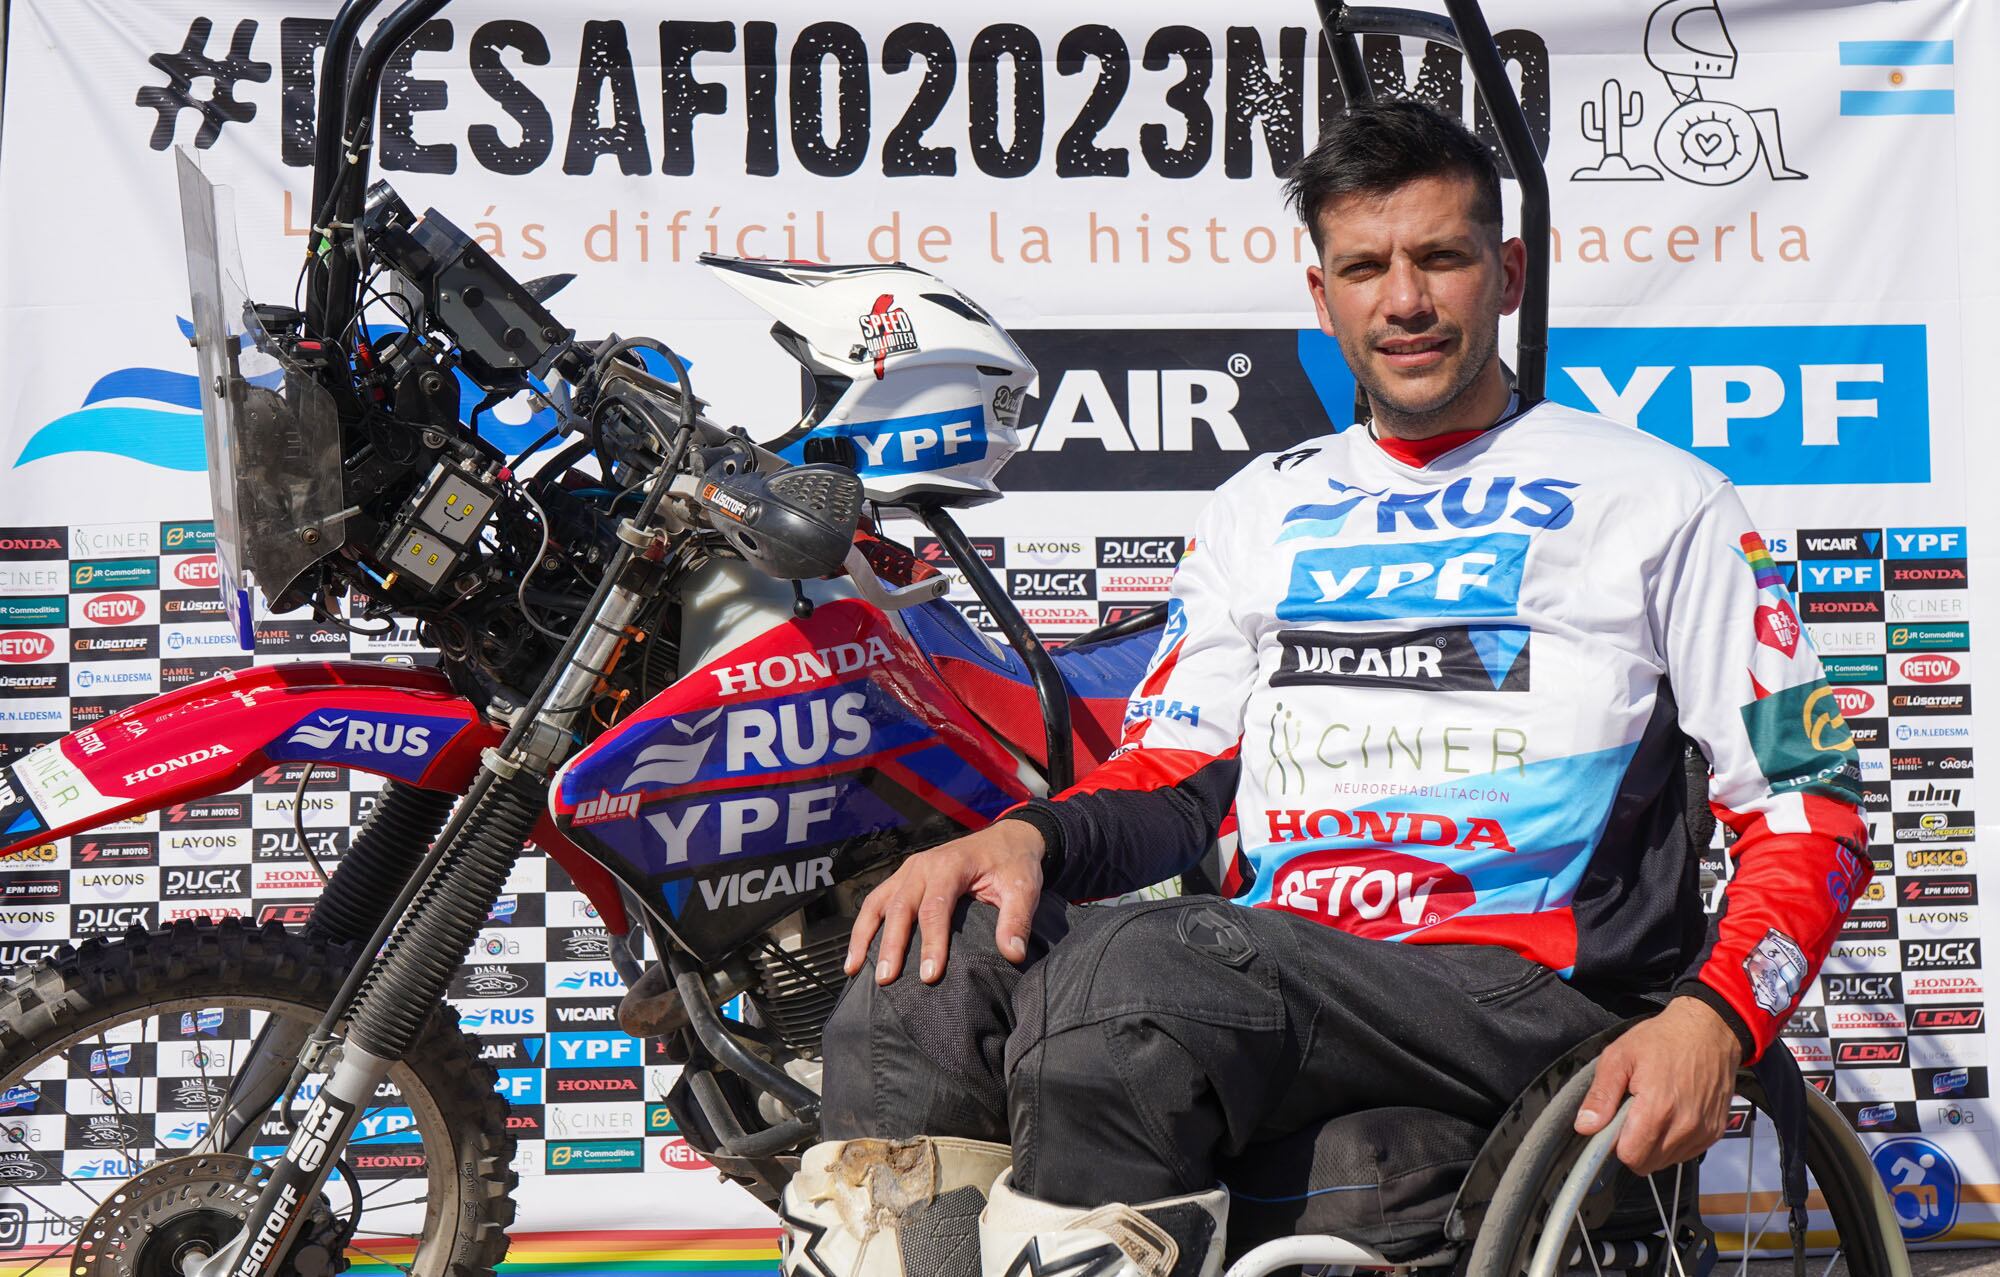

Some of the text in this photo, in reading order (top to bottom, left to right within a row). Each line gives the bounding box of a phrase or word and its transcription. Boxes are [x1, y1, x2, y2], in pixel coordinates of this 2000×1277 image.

[584, 208, 833, 262] difícil
[868, 212, 953, 263] de
[990, 212, 1052, 263] la
[860, 311, 911, 338] SPEED
[1562, 364, 1884, 448] YPF
[853, 421, 973, 466] YPF
[1377, 476, 1582, 533] RUS
[0, 538, 62, 550] ONDA
[94, 531, 149, 548] CINER
[1765, 539, 1787, 552] US
[1806, 537, 1857, 551] VICAIR
[1894, 534, 1959, 552] YPF
[1018, 543, 1081, 553] LAYONS
[1104, 541, 1175, 563] DUCK
[104, 566, 151, 577] Commodities
[178, 563, 218, 580] RETO
[1309, 553, 1498, 603] YPF
[1809, 567, 1872, 585] YPF
[1894, 569, 1965, 580] HONDA
[1015, 573, 1088, 595] DUCK
[88, 600, 138, 618] RETOV
[1022, 608, 1089, 618] HONDA
[1809, 602, 1878, 613] HONDA
[1908, 599, 1962, 613] CINER
[1822, 631, 1876, 646] CINER
[1919, 630, 1964, 639] Commodities
[710, 636, 895, 697] HONDA
[1296, 645, 1443, 678] VICAIR
[1834, 664, 1878, 672] Commodities
[1904, 661, 1952, 677] RETOV
[1835, 694, 1866, 710] TOV
[345, 720, 431, 757] RUS
[725, 693, 872, 772] RUS
[1317, 723, 1529, 779] CINER
[122, 743, 233, 787] HONDA
[1334, 782, 1511, 803] NEUROREHABILITACIÓN
[1864, 794, 1889, 803] AGSA
[191, 807, 239, 817] EPM MOTOS
[645, 785, 838, 866] YPF
[1265, 809, 1517, 853] HONDA
[172, 836, 237, 849] LAYONS
[262, 832, 340, 855] DUCK
[102, 847, 149, 856] EPM MOTOS
[1907, 849, 1968, 868] UKKO
[83, 874, 144, 887] LAYONS
[168, 870, 241, 892] DUCK
[698, 855, 835, 912] VICAIR
[28, 885, 58, 893] MOTOS
[1278, 866, 1445, 926] RETOV
[1924, 886, 1969, 895] EPM MOTOS
[0, 911, 55, 923] AYONS
[79, 908, 149, 931] DUCK
[1861, 921, 1887, 929] MOTOS
[1910, 912, 1968, 924] LAYONS
[0, 946, 59, 964] UCK
[1830, 946, 1886, 958] LAYONS
[1908, 943, 1975, 964] DUCK
[474, 965, 509, 975] DASAL
[1830, 977, 1893, 998] DUCK
[1914, 978, 1977, 988] HONDA
[491, 1009, 534, 1025] RUS
[556, 1008, 616, 1022] VICAIR
[1838, 1012, 1897, 1022] HONDA
[1917, 1010, 1978, 1026] LCM
[558, 1039, 633, 1060] YPF
[1789, 1045, 1824, 1055] NDA
[1842, 1045, 1900, 1061] LCM
[493, 1077, 533, 1097] PF
[557, 1079, 638, 1092] HONDA
[362, 1116, 421, 1136] YP
[573, 1112, 633, 1129] CINER
[584, 1149, 635, 1158] Commodities
[103, 1160, 144, 1176] RUS
